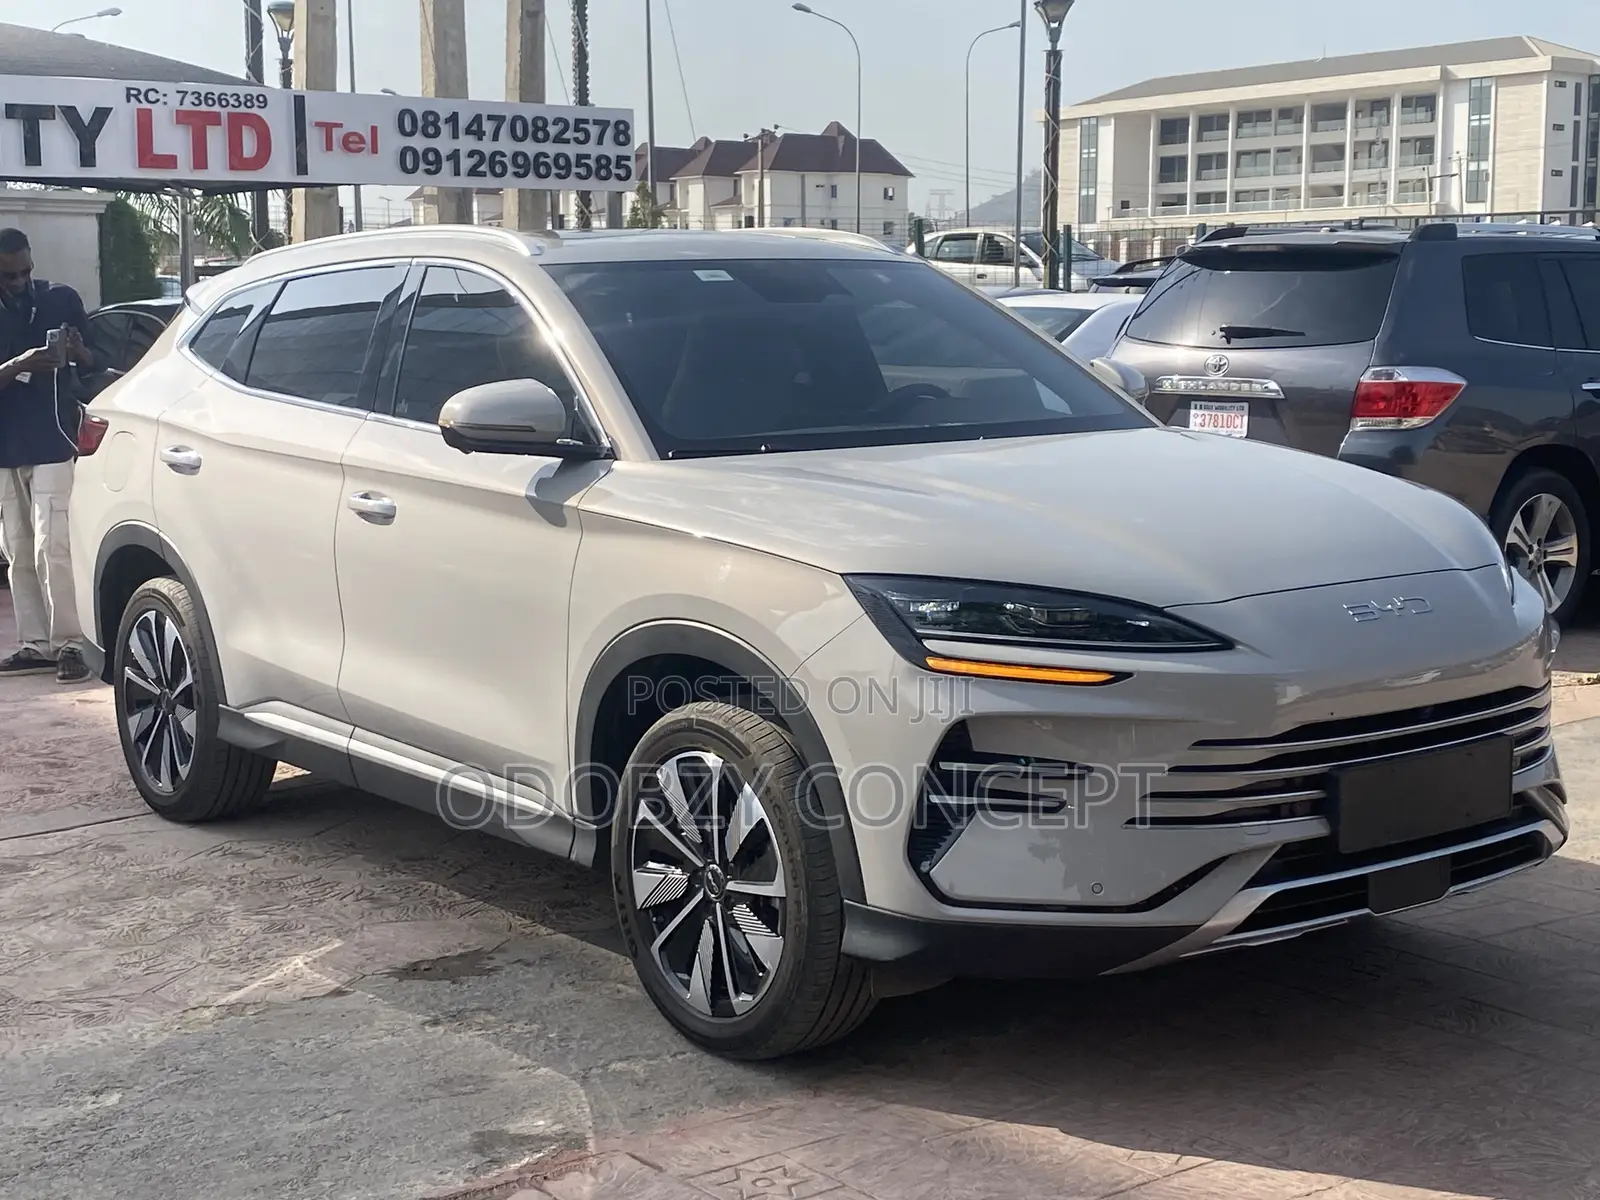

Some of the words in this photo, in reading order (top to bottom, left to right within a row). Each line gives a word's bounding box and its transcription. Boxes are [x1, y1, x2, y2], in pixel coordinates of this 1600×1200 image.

[125, 86, 168, 106] RC:
[176, 90, 268, 109] 7366389
[5, 103, 114, 168] TY
[136, 107, 272, 171] LTD
[314, 121, 379, 155] Tel
[397, 108, 631, 147] 08147082578
[399, 145, 633, 182] 09126969585
[1342, 596, 1433, 622] BYD
